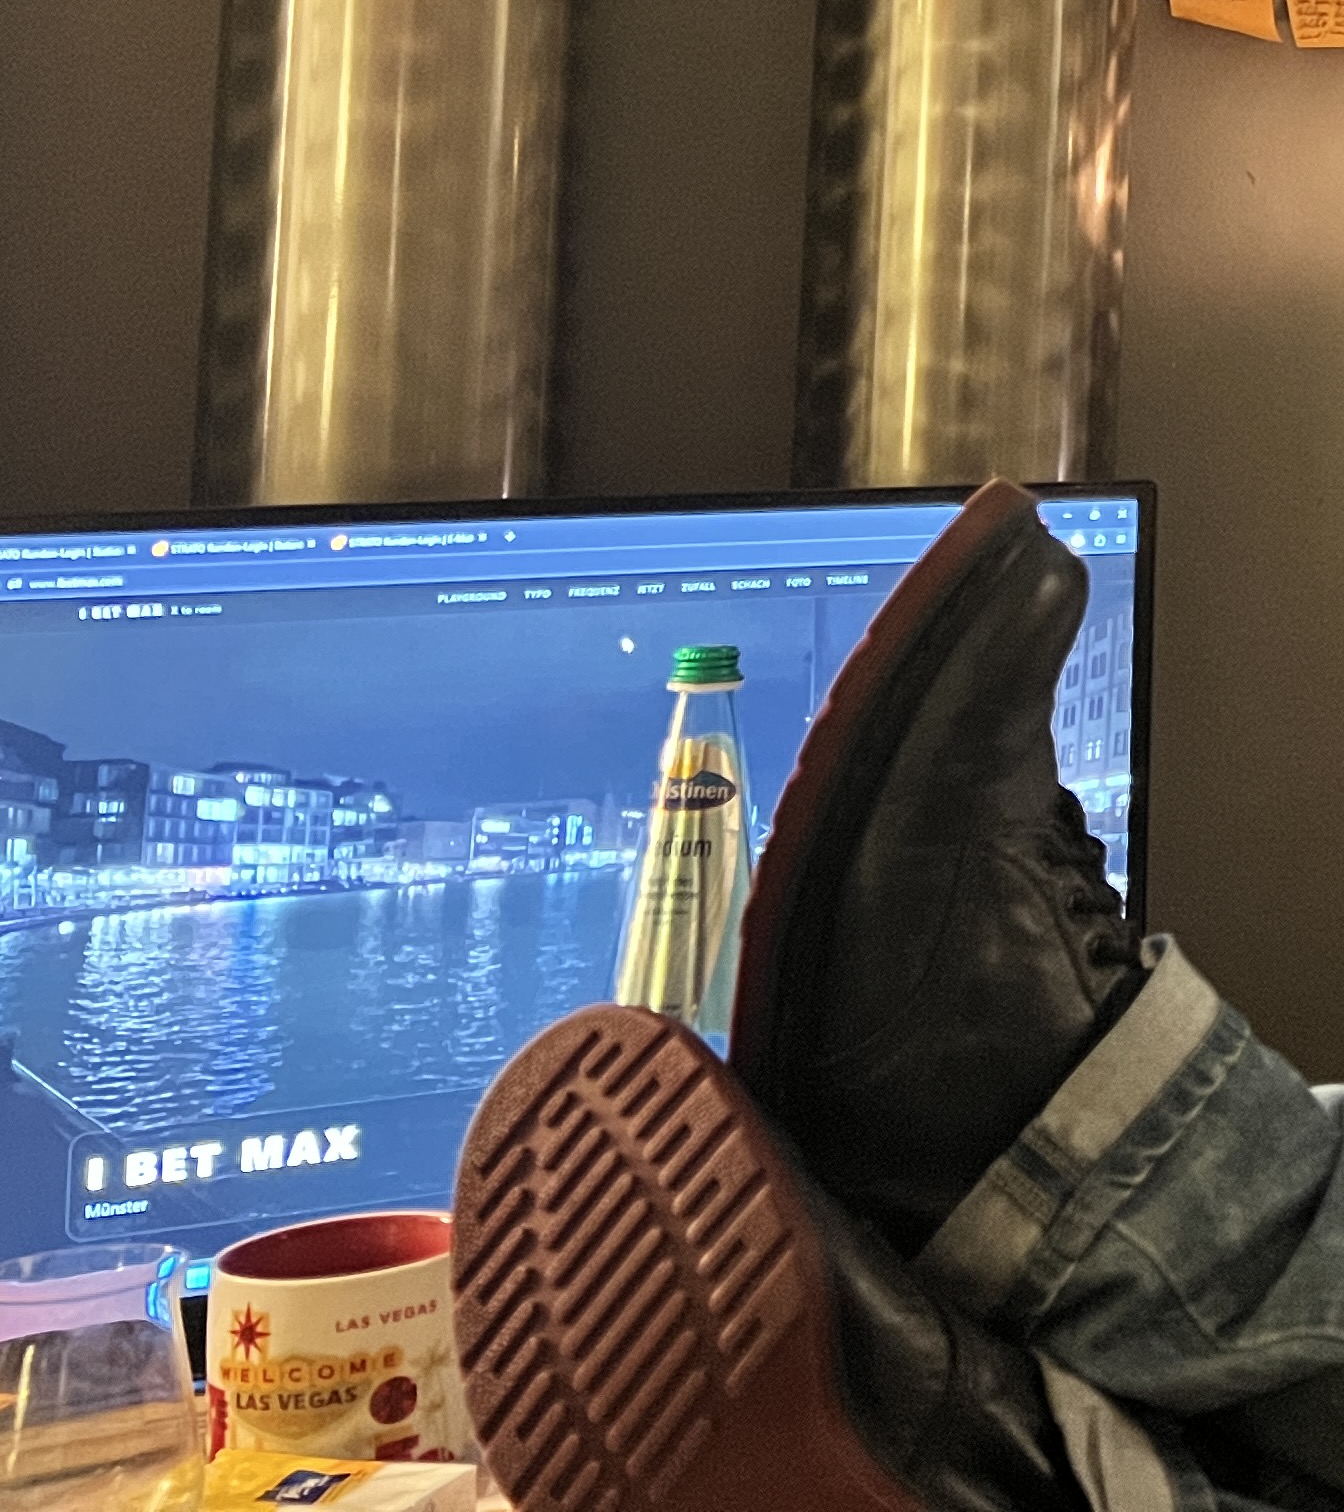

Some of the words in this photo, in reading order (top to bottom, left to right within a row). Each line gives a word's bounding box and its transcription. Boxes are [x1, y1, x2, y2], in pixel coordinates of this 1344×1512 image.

[731, 579, 771, 591] SCHACH
[785, 577, 812, 588] FOTO
[826, 574, 869, 586] TIMELINE
[437, 590, 508, 604] PLAYGROUND
[91, 605, 122, 620] BET
[126, 603, 164, 619] MAX
[86, 1157, 104, 1191] I
[124, 1142, 223, 1188] BET
[240, 1124, 360, 1173] MAX
[84, 1199, 149, 1219] Münster
[335, 1315, 370, 1334] LAS
[378, 1299, 438, 1325] VEGAS
[220, 1351, 396, 1383] WELCOME
[235, 1392, 271, 1412] LAS
[277, 1385, 358, 1411] VEGAS
